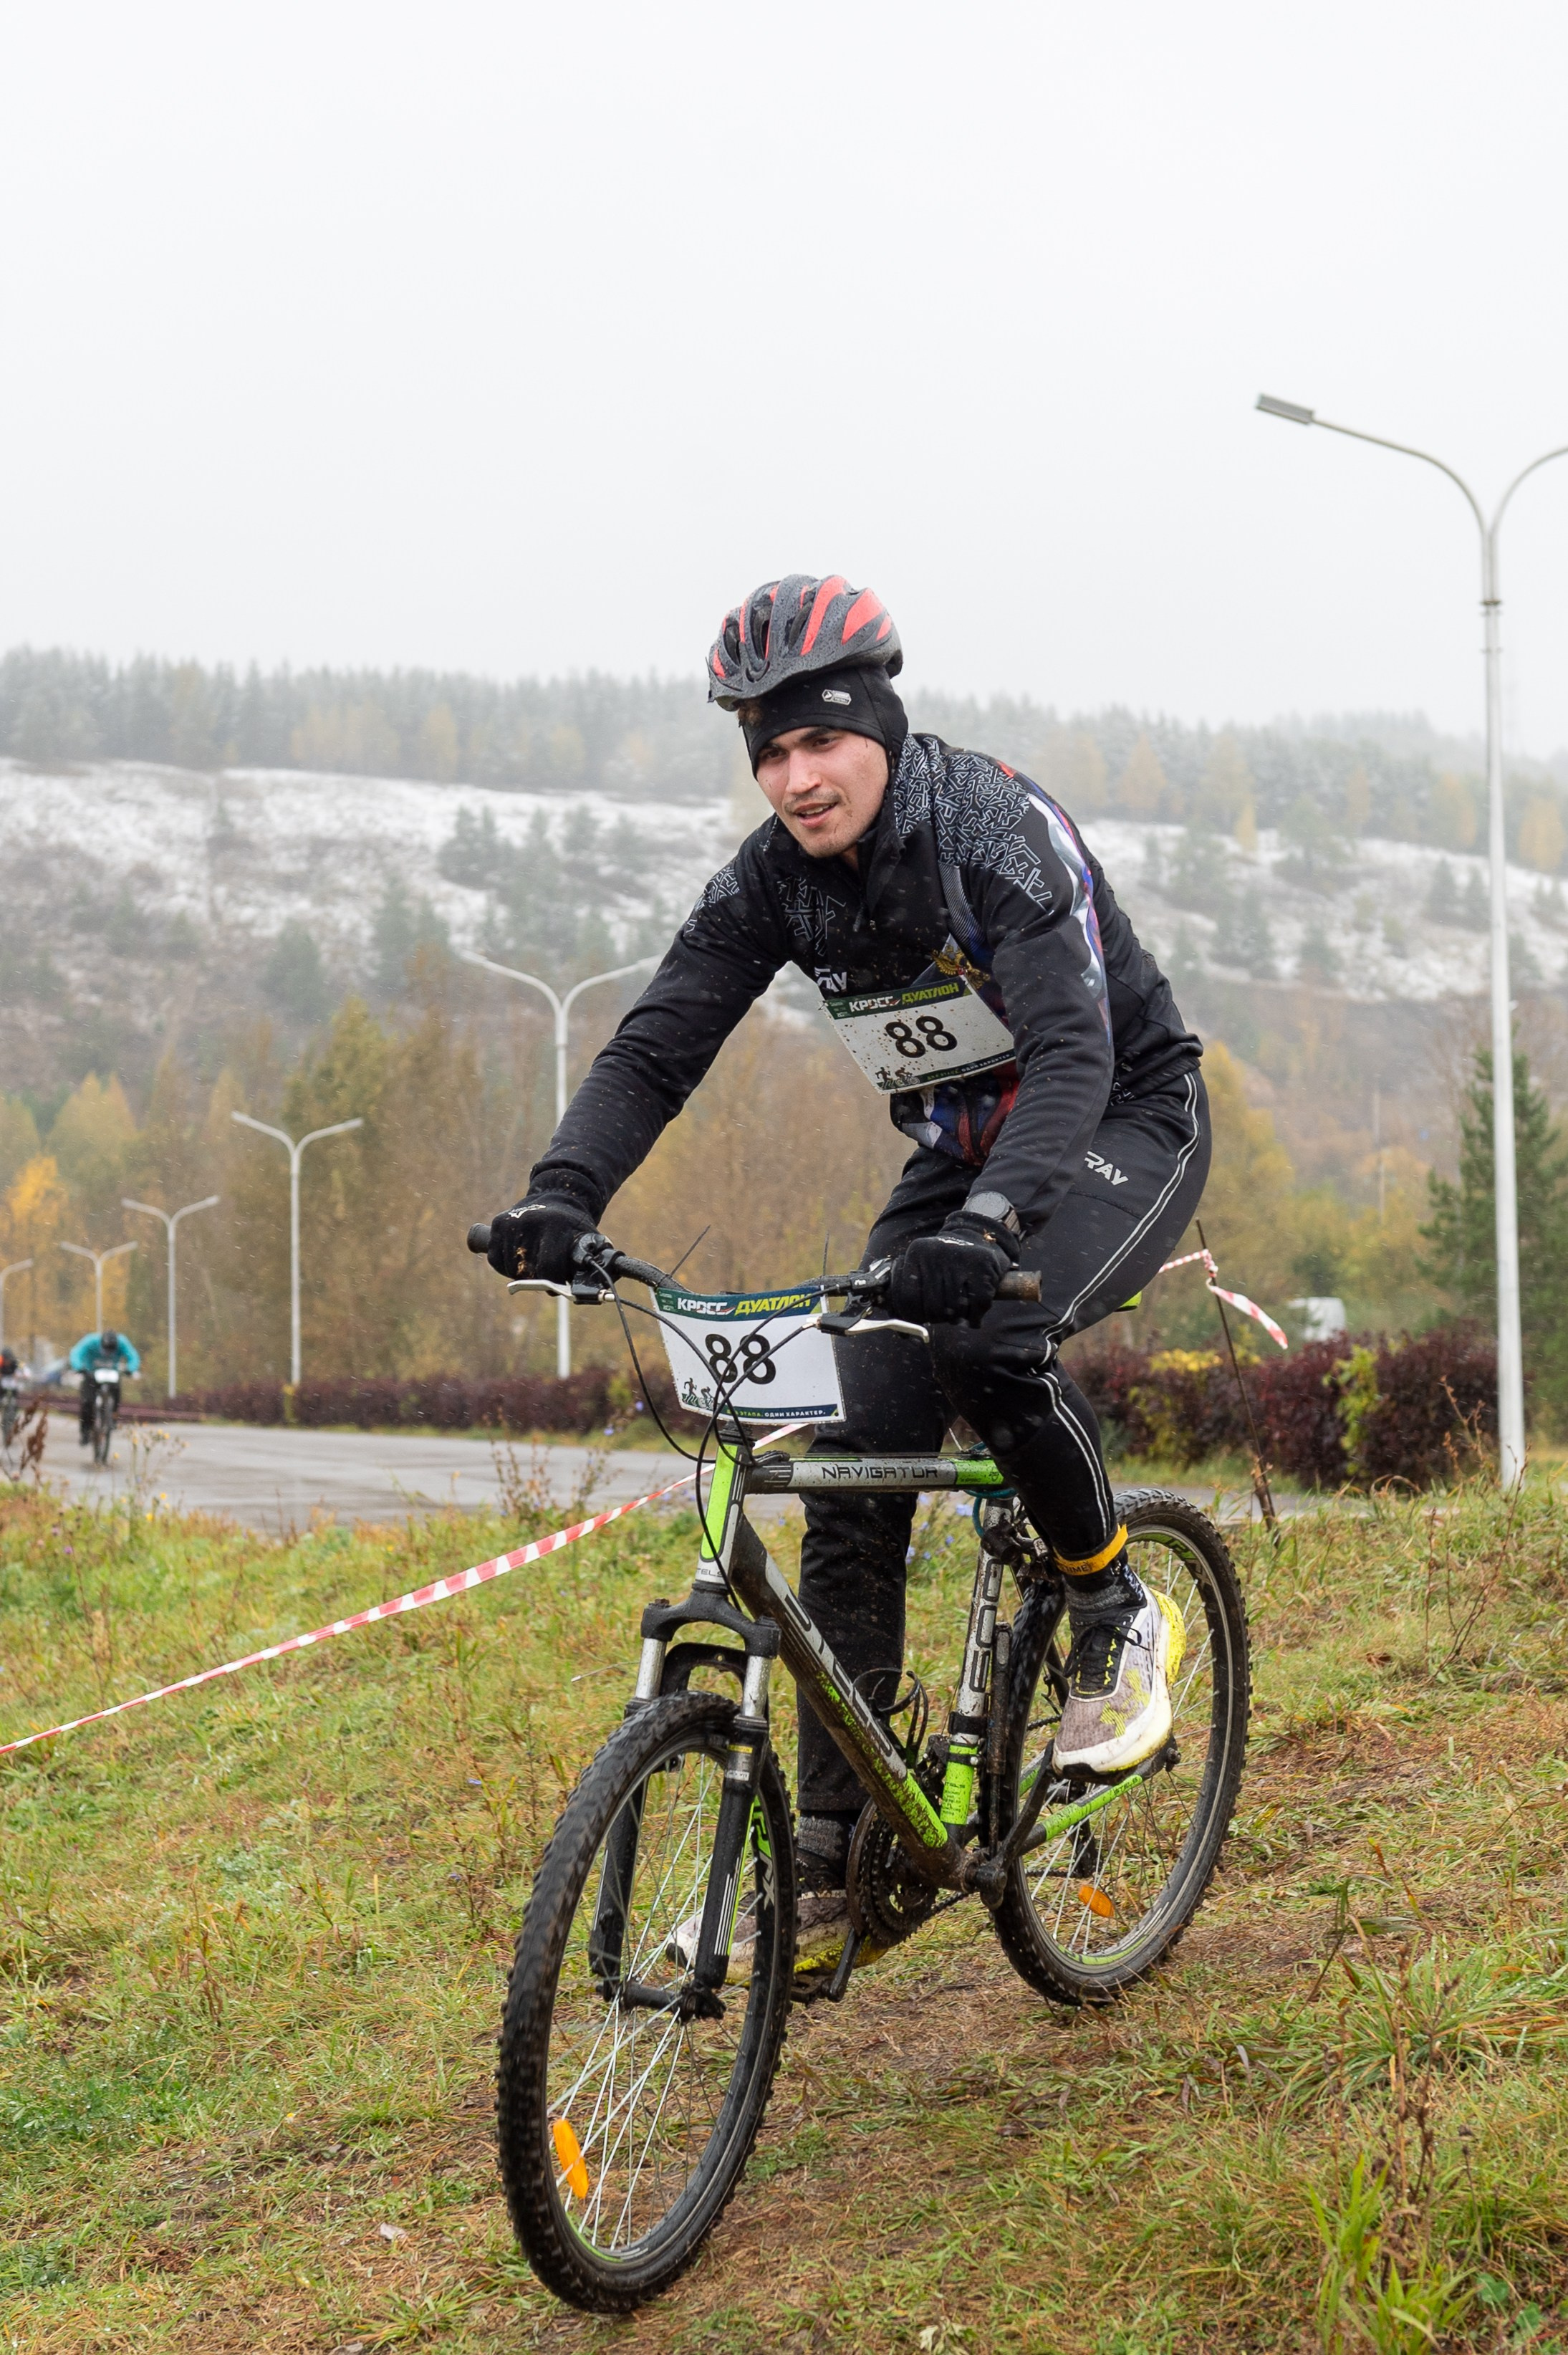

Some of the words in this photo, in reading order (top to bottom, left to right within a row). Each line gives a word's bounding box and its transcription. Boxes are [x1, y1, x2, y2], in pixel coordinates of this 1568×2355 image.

[849, 995, 898, 1012] КРОСС
[901, 982, 959, 1004] ДУАТЛОН
[885, 1015, 957, 1058] 88
[678, 1298, 734, 1315] КРОСС
[734, 1293, 811, 1316] ДУАТЛОН
[705, 1333, 776, 1385] 88
[822, 1465, 938, 1480] NAVIGATOR
[696, 1568, 723, 1578] TELS
